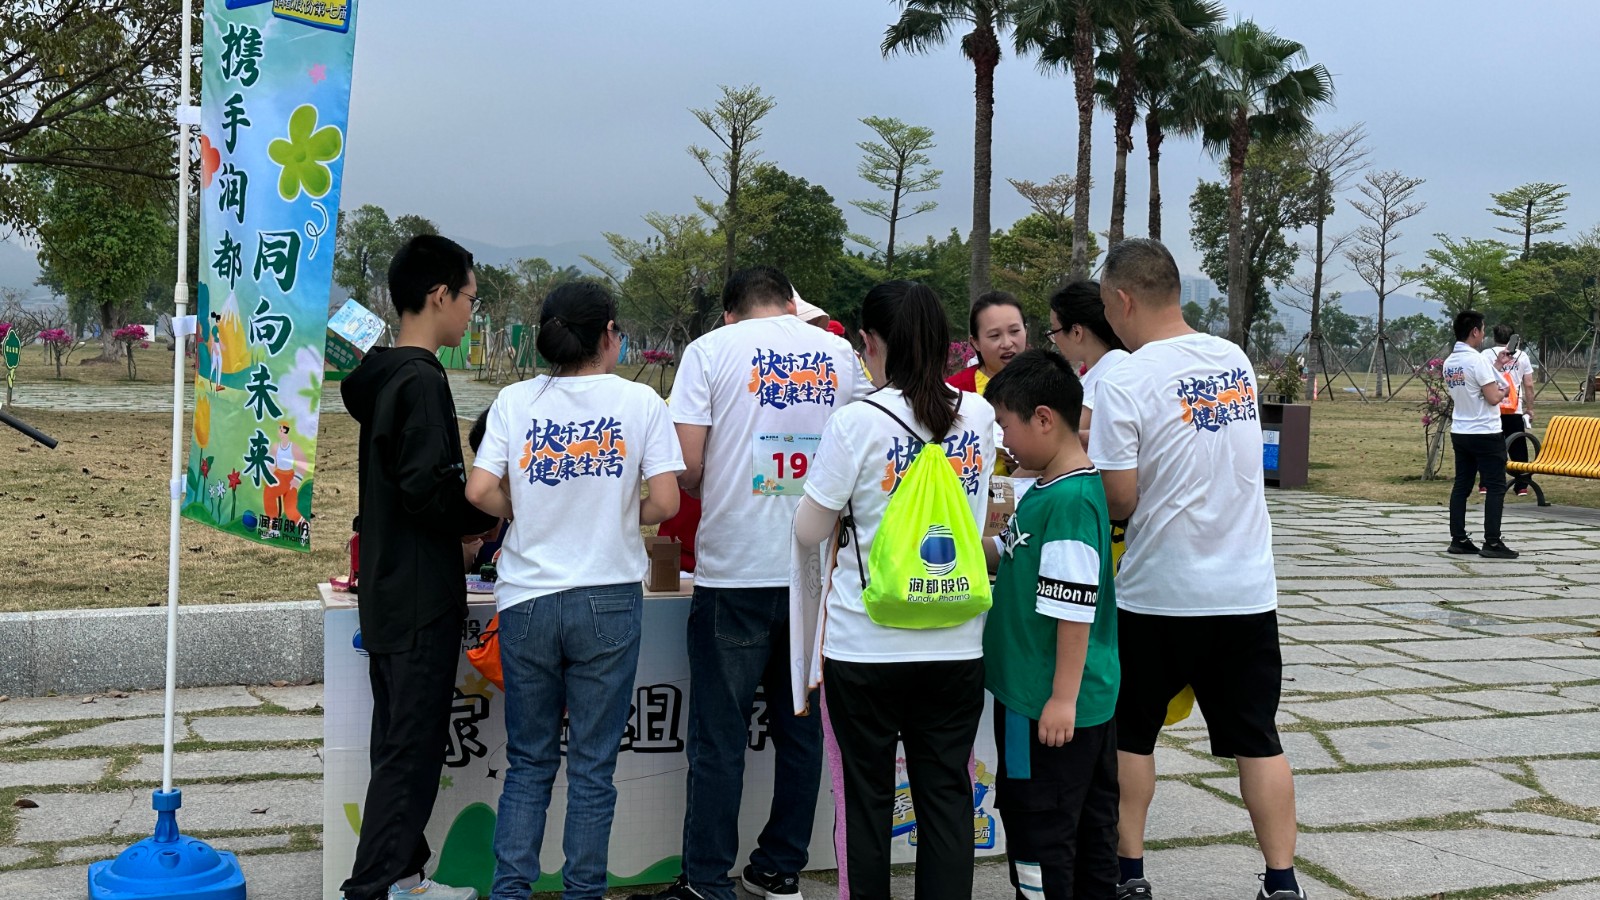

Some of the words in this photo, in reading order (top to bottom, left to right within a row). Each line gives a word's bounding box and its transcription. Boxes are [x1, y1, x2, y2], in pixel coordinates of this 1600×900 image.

[212, 24, 263, 289] 携手润都
[243, 231, 301, 487] 同向未来
[752, 348, 836, 379] 快乐工作
[754, 379, 836, 410] 健康生活
[1177, 367, 1252, 406] 快乐工作
[1189, 395, 1257, 432] 健康生活
[525, 416, 624, 453] 快乐工作
[886, 430, 981, 474] 快工作
[524, 449, 624, 486] 健康生活
[772, 452, 817, 479] 19
[259, 514, 309, 536] 润都股份
[907, 593, 934, 603] Rundu
[938, 593, 970, 603] Pharma
[909, 576, 970, 594] 润都股份
